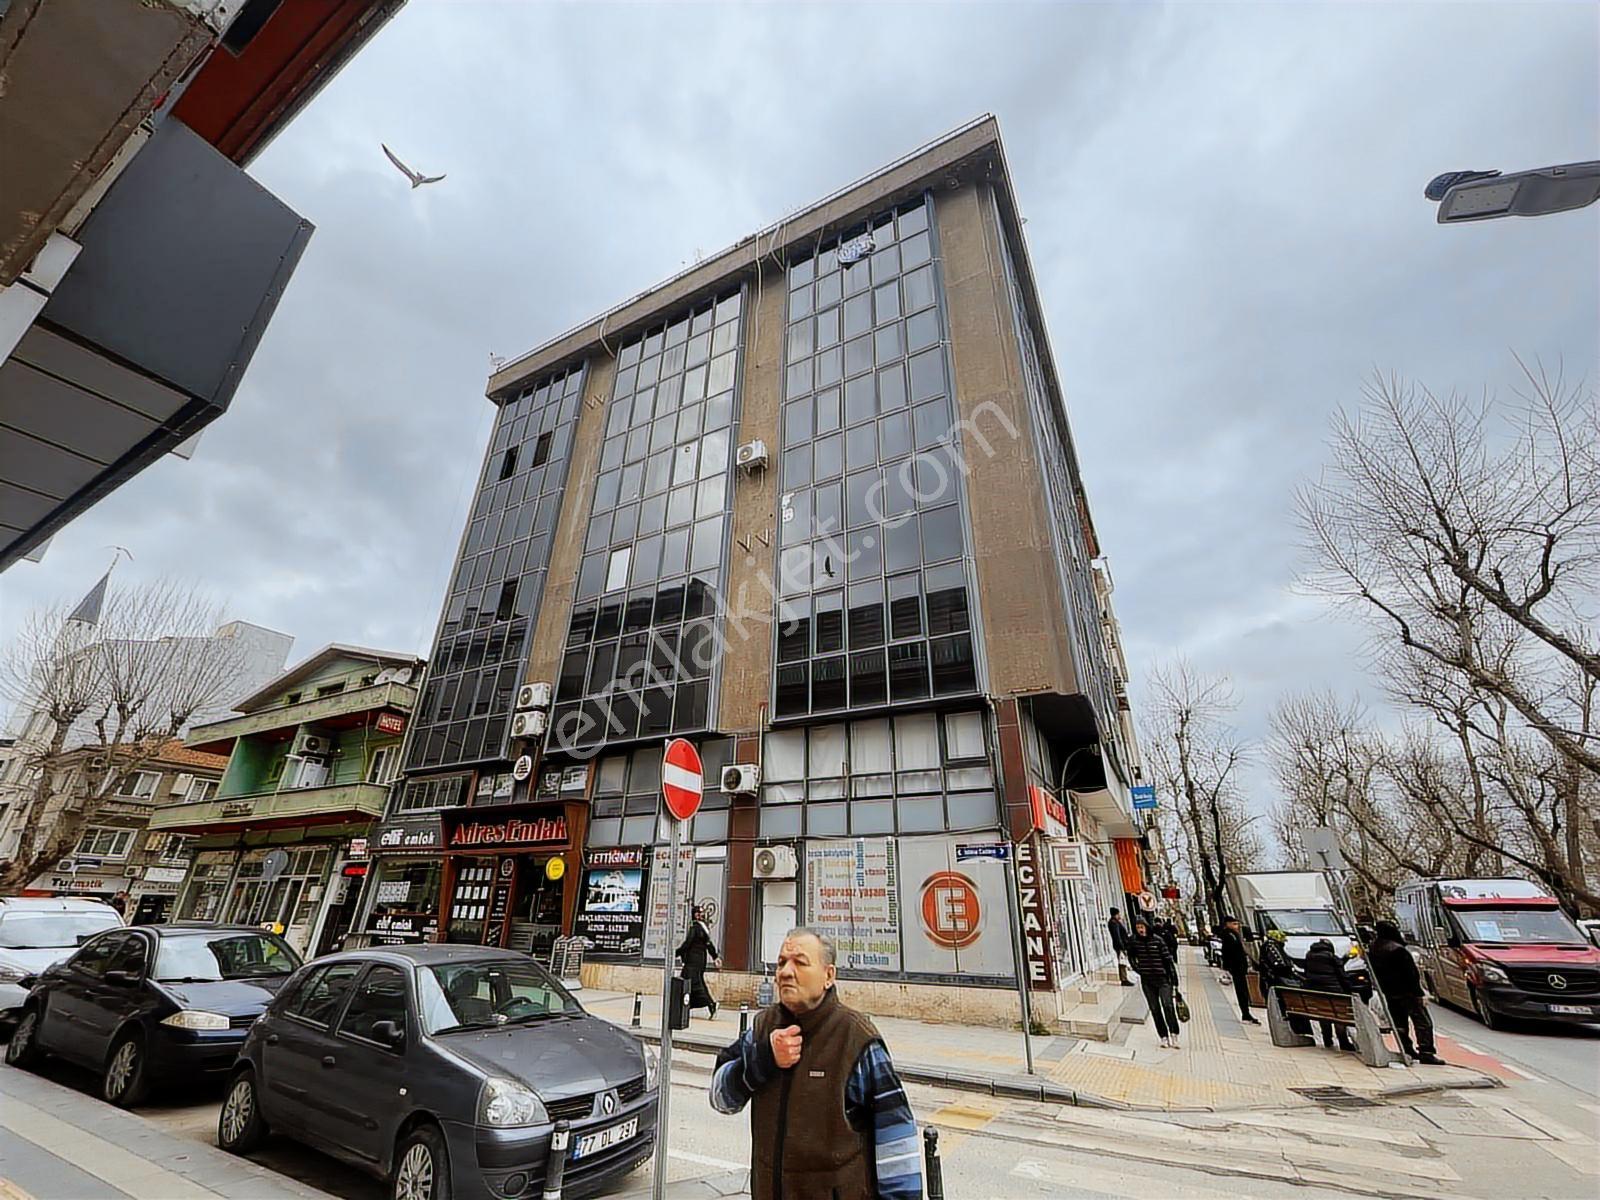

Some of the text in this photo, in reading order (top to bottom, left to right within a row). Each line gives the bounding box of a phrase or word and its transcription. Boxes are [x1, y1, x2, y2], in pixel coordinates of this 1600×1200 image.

[450, 816, 567, 844] Adres Emlak
[656, 850, 691, 860] ECNE
[1059, 852, 1079, 873] E
[934, 888, 968, 931] E
[1017, 843, 1047, 981] ECZANE
[582, 1120, 636, 1154] 77 DL 297
